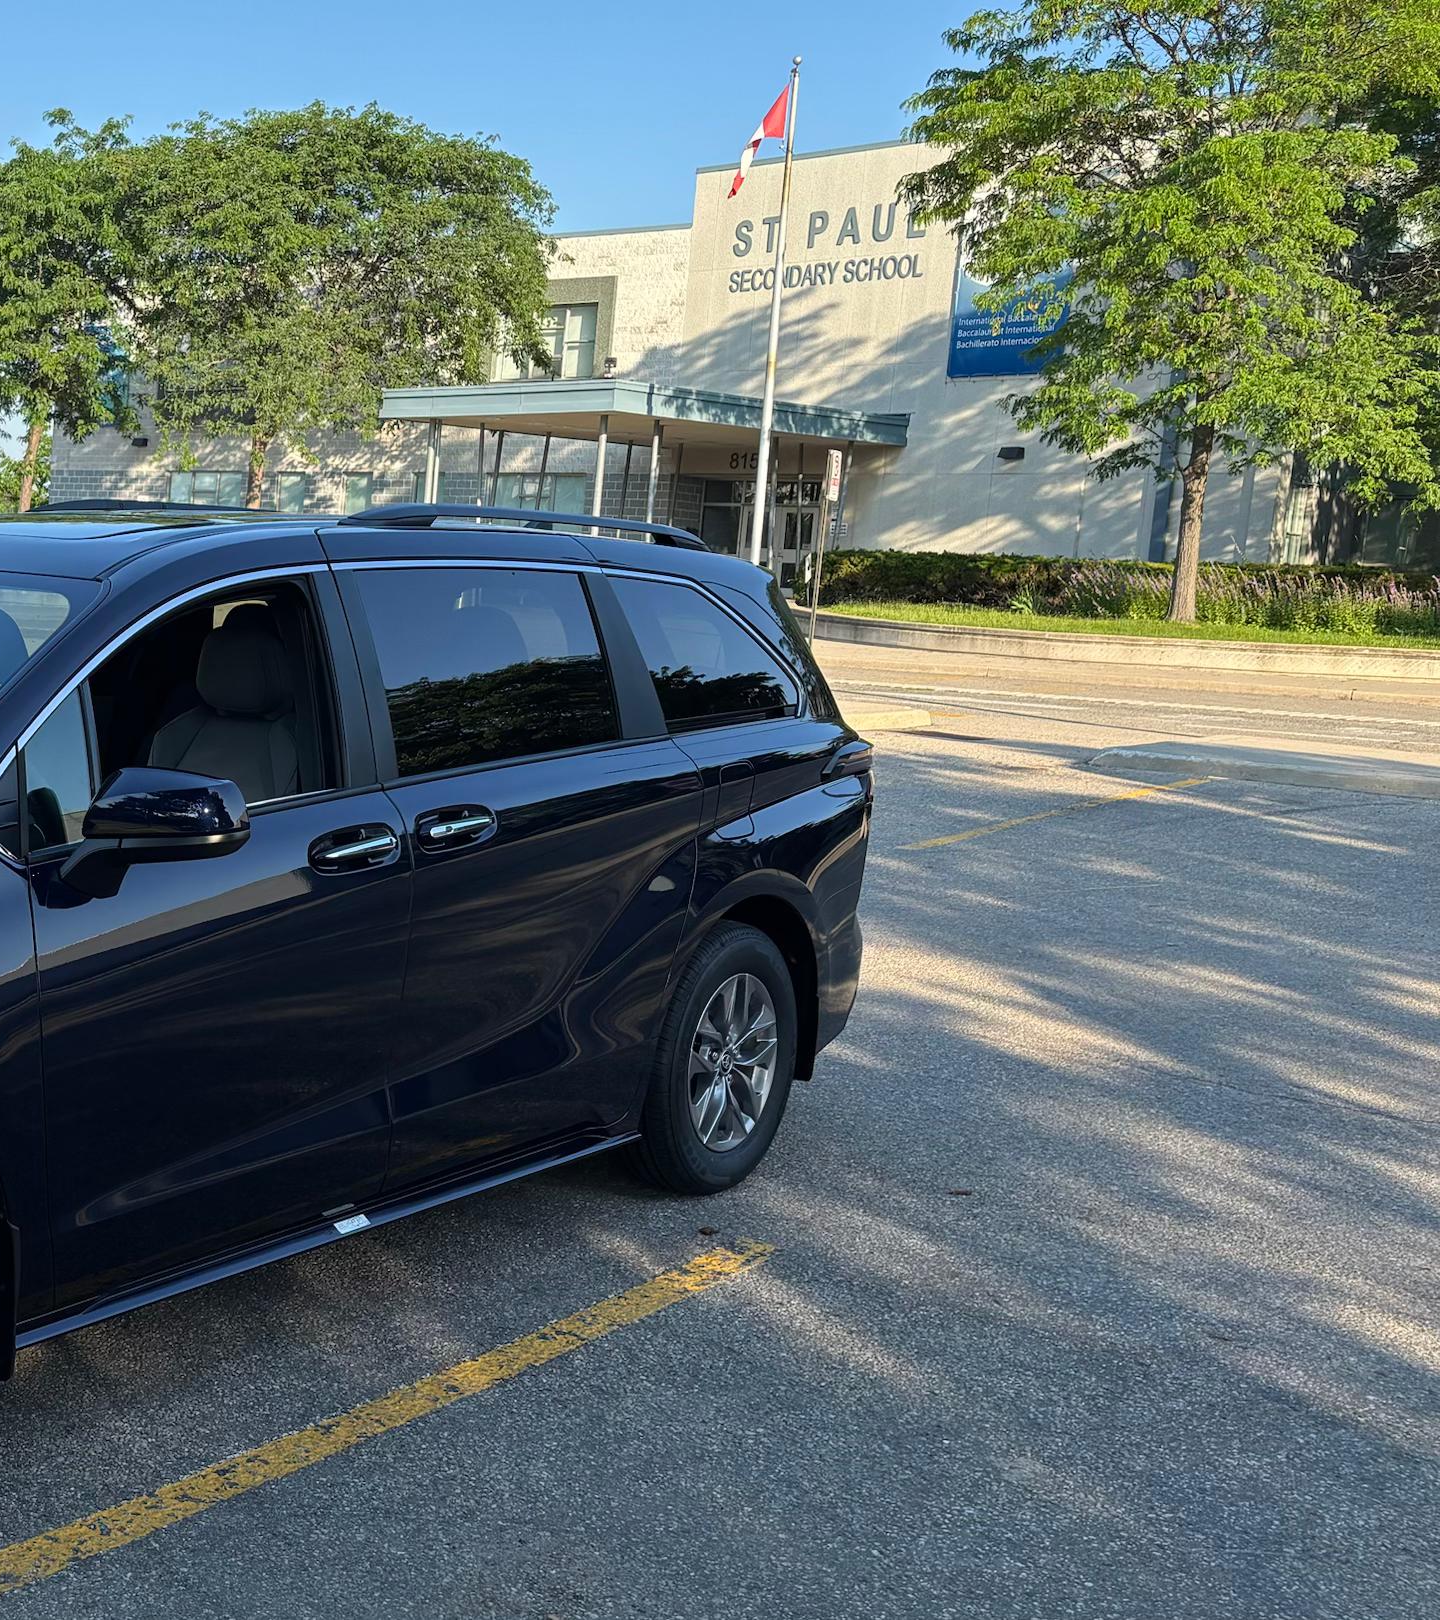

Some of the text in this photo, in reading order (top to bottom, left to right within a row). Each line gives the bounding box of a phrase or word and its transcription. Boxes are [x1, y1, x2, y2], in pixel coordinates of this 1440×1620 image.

[732, 201, 927, 257] ST PAUL
[729, 254, 923, 293] SECONDARY SCHOOL
[729, 452, 759, 469] 815
